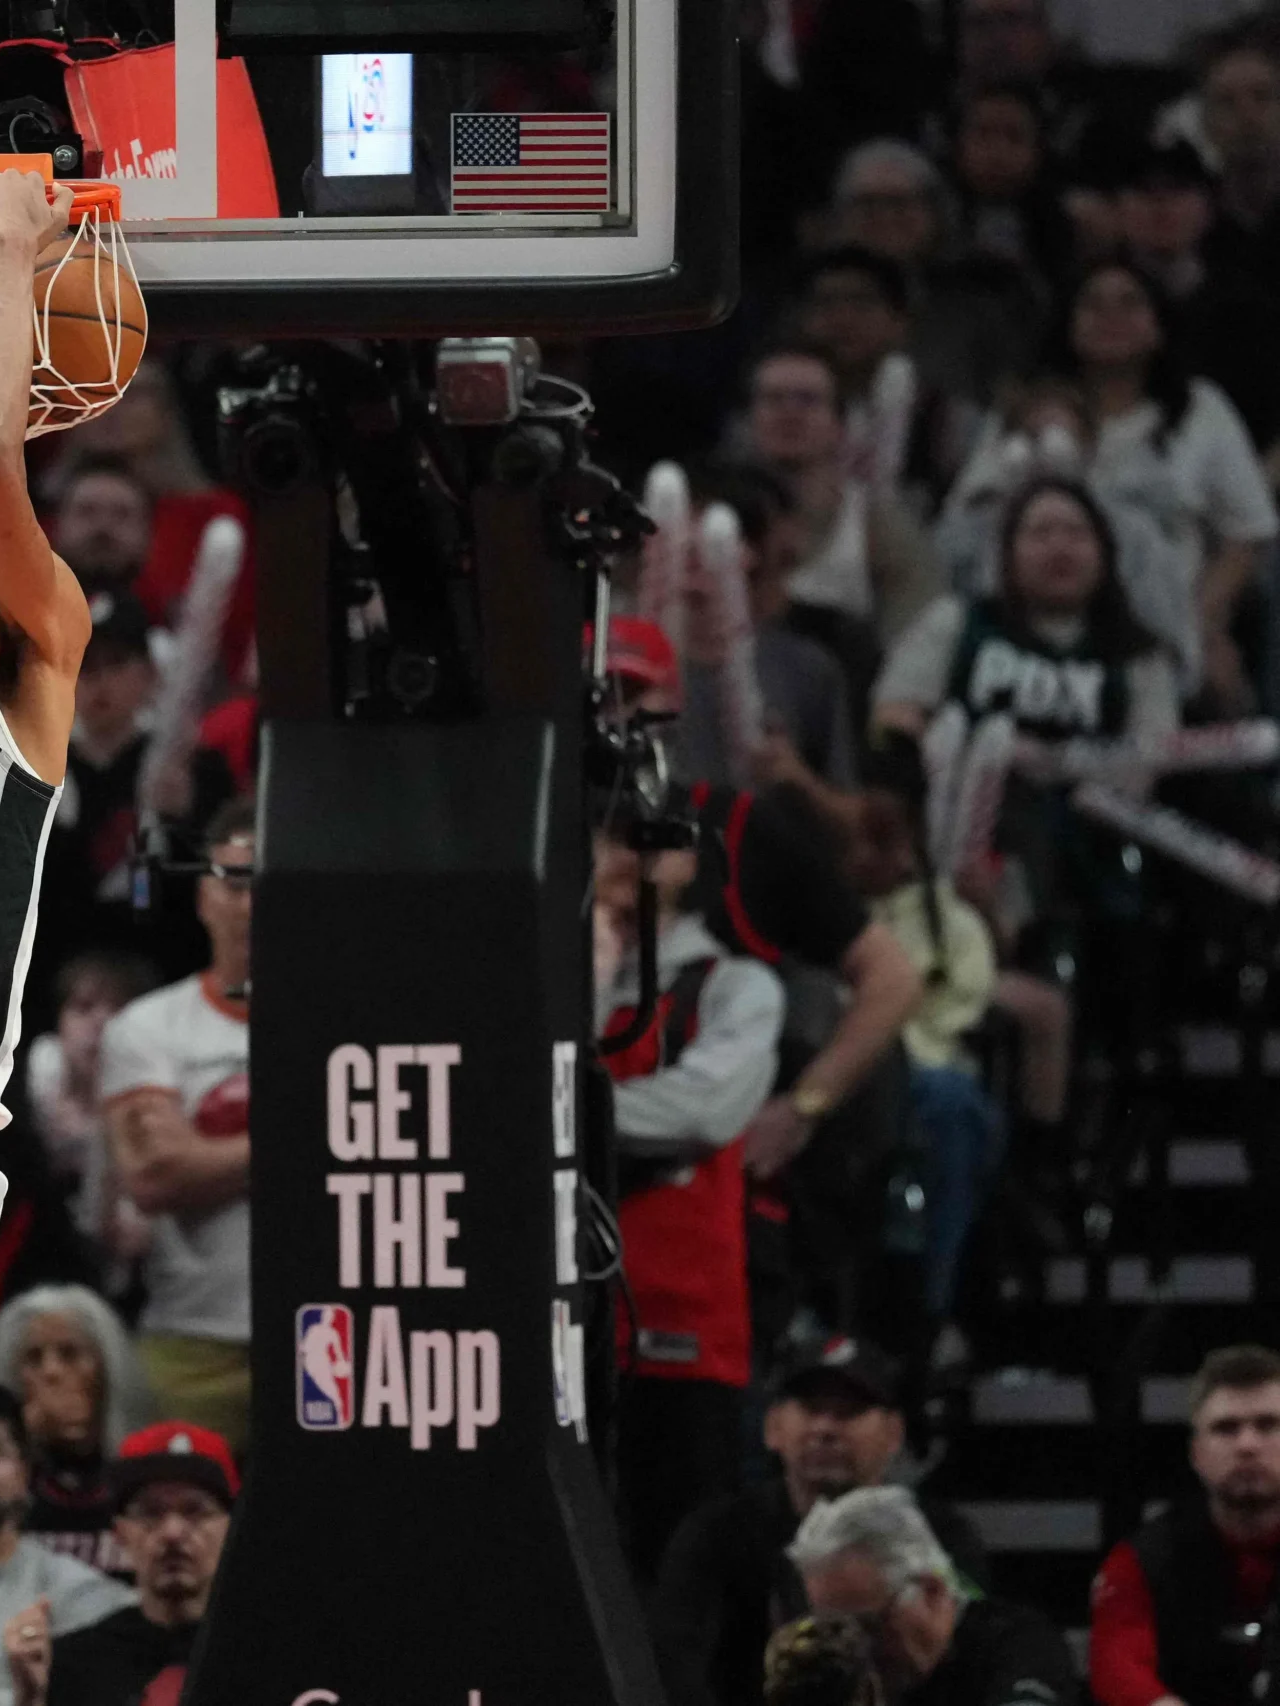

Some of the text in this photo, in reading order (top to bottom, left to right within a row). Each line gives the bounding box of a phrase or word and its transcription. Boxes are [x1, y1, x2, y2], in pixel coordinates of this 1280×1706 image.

[326, 1043, 461, 1161] GET
[326, 1172, 466, 1288] THE
[361, 1305, 501, 1451] App
